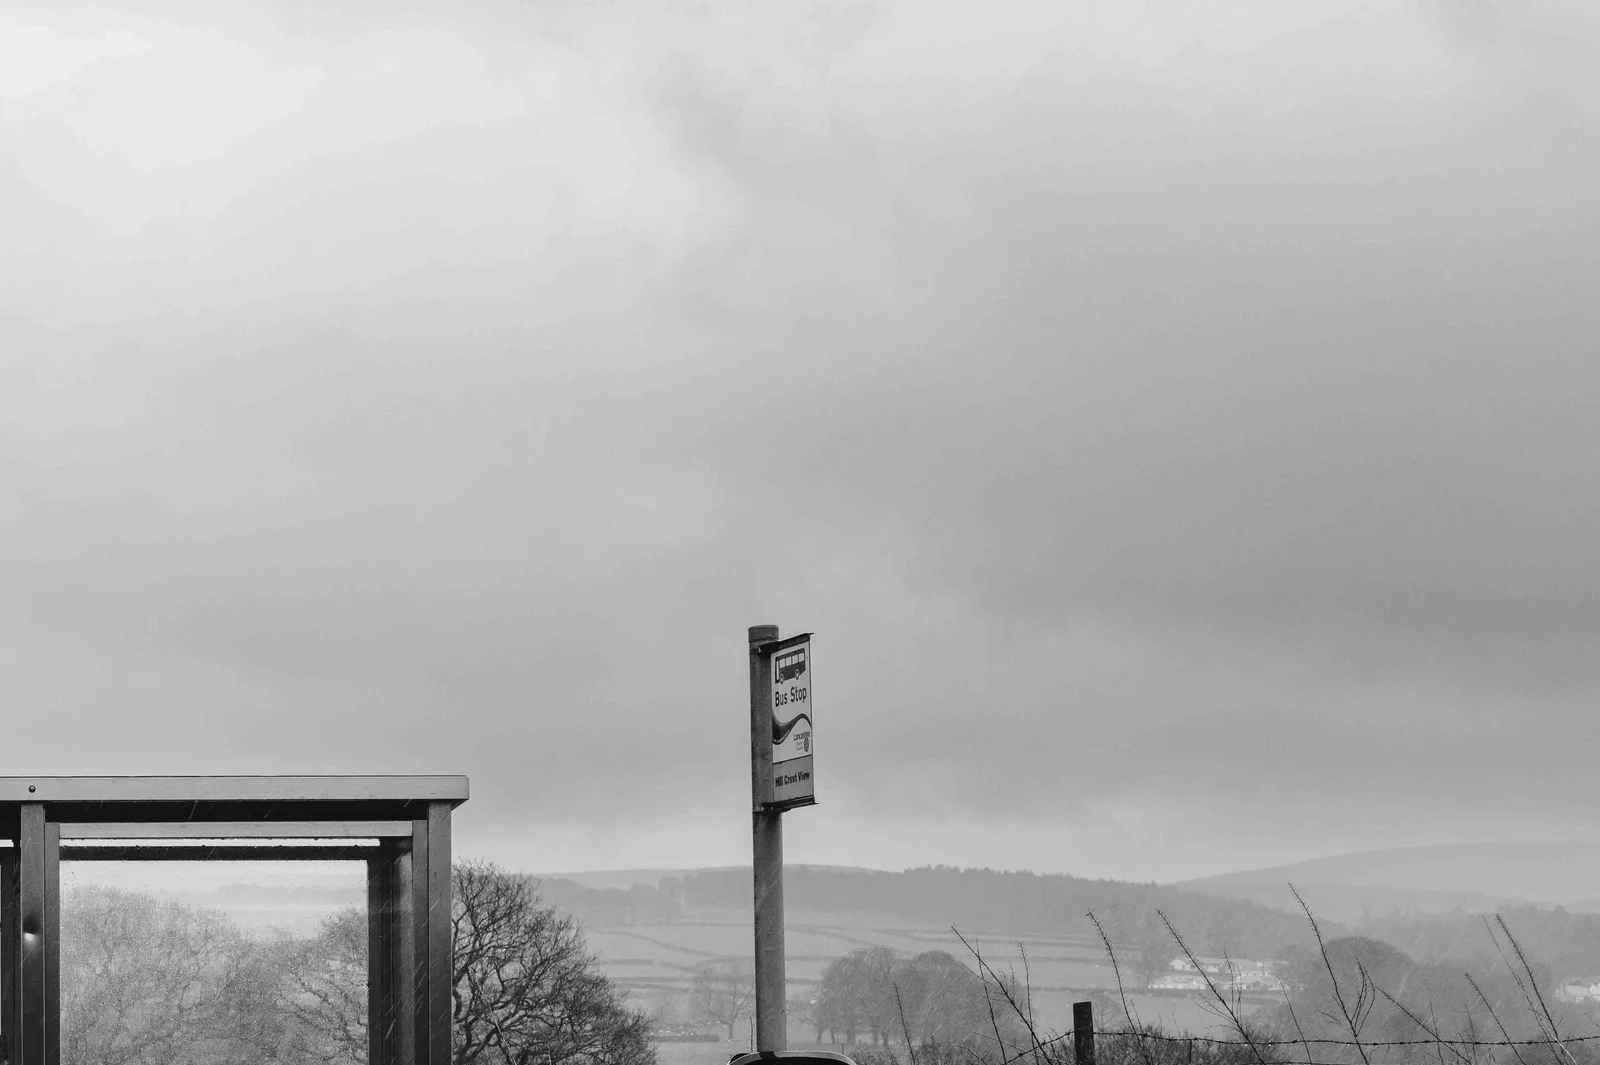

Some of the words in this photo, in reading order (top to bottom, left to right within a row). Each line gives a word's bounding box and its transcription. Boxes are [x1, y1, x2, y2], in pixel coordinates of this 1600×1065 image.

[775, 691, 787, 707] Bus
[791, 686, 807, 703] Stop
[784, 773, 797, 785] Crest
